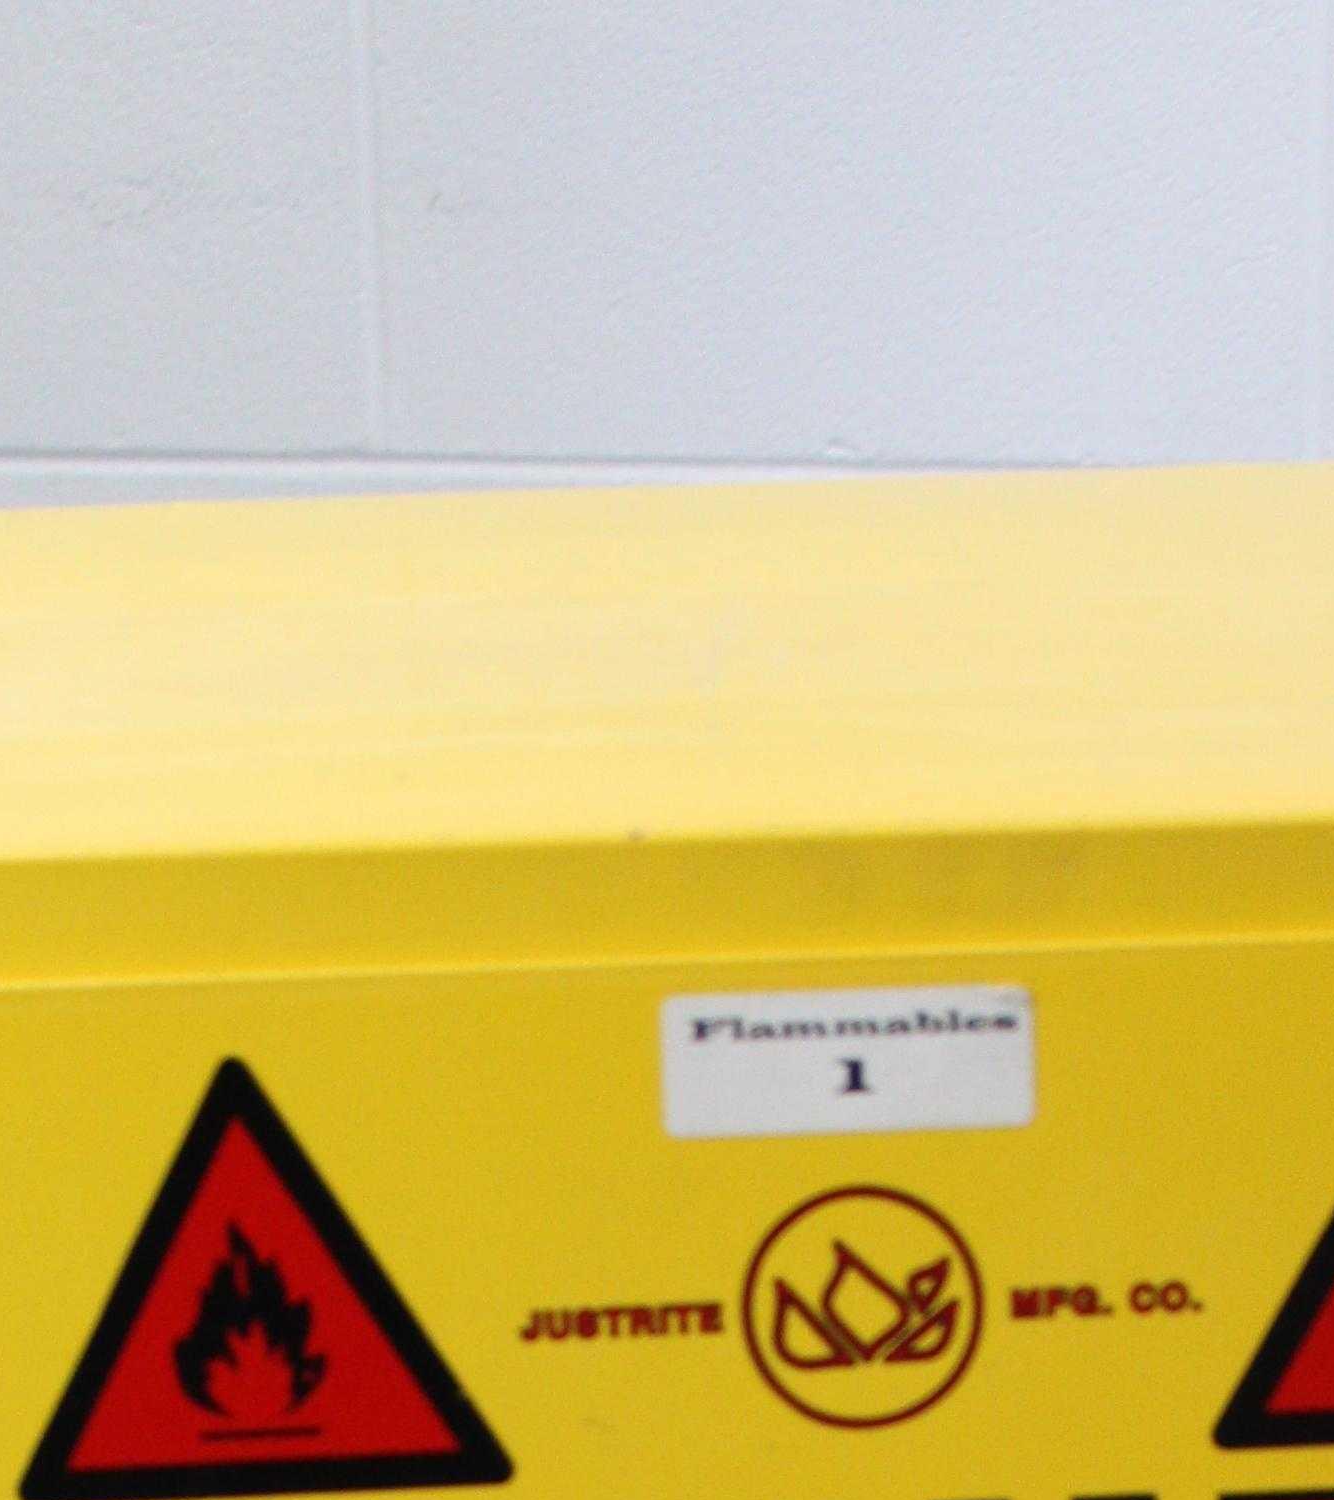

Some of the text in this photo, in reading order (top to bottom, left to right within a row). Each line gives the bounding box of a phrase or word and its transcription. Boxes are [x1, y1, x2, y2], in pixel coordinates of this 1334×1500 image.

[690, 1009, 1019, 1043] Flammables
[835, 1058, 873, 1093] 1
[519, 1280, 1204, 1341] JUSTRITE MFG. CO.
